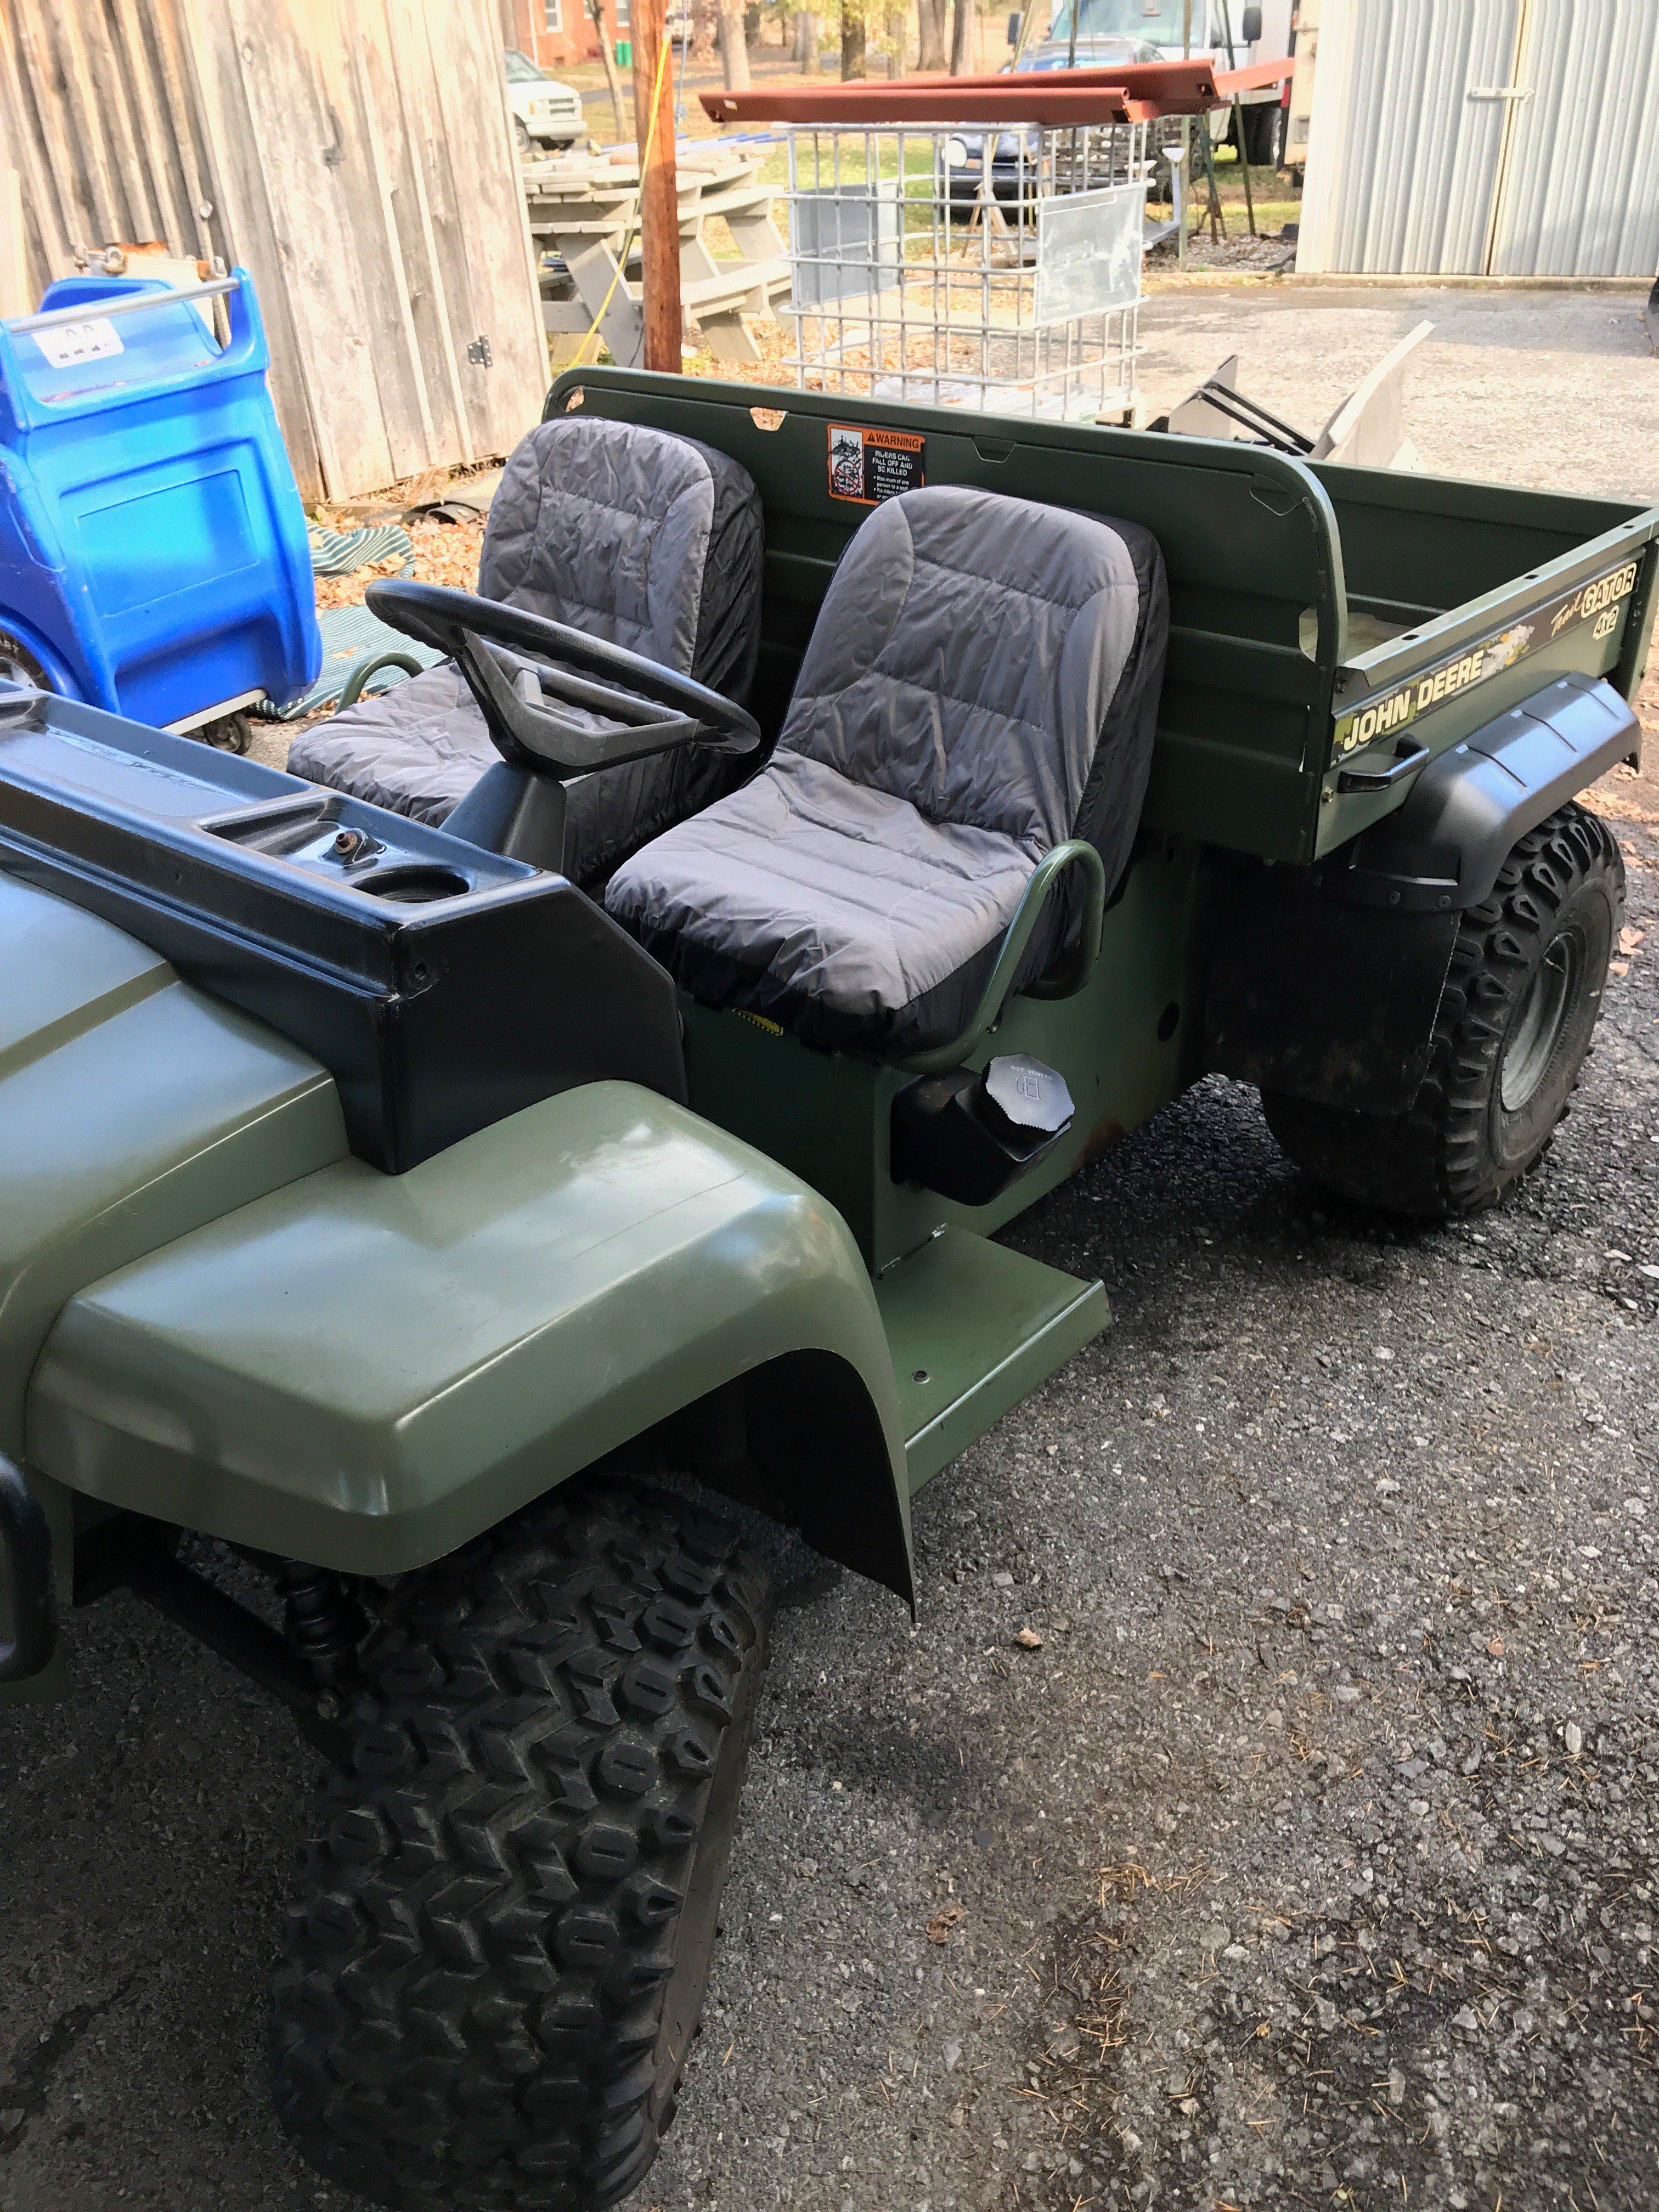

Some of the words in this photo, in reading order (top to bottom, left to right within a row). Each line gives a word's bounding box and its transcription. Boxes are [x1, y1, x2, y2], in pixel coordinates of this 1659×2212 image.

[876, 432, 919, 449] WARNING
[872, 457, 886, 466] FALL
[900, 461, 913, 470] AND
[887, 467, 907, 476] KILLED
[1581, 562, 1637, 619] GATOR
[1344, 690, 1411, 751] JOHN
[1417, 650, 1484, 711] DEERE
[1028, 1069, 1052, 1081] VENTED
